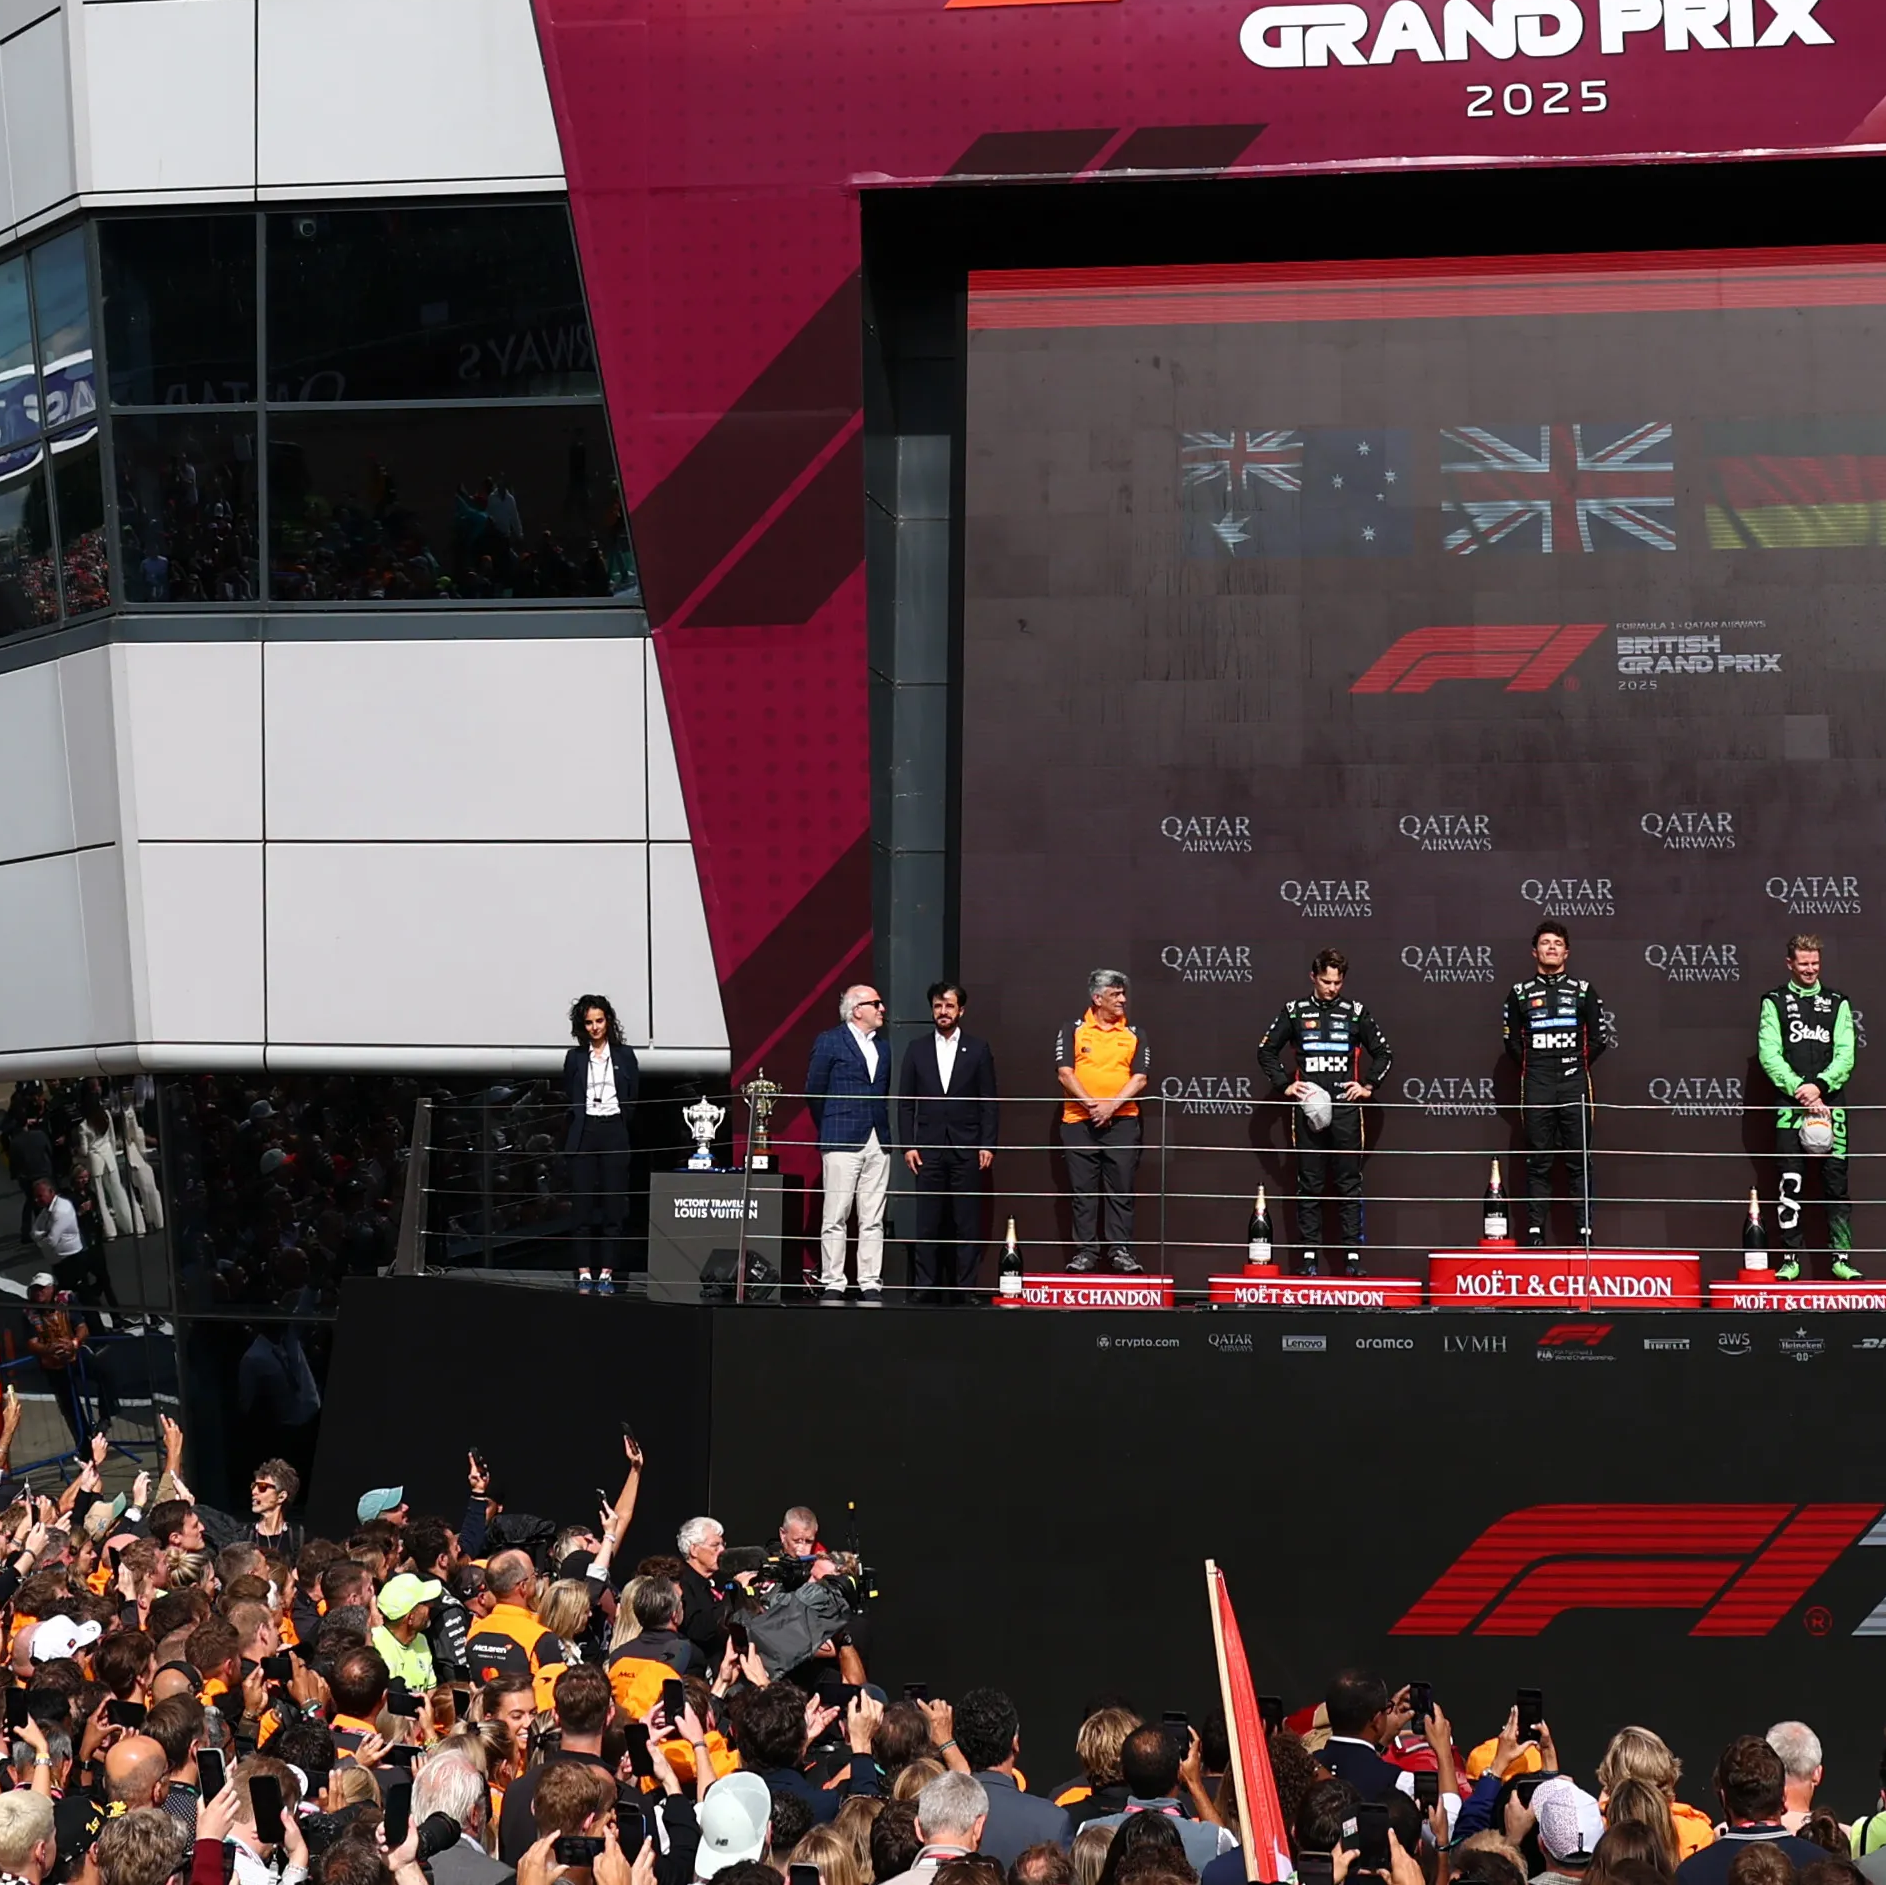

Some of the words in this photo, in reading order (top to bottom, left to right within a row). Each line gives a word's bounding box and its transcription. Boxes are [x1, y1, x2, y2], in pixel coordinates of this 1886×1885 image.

[1466, 80, 1609, 119] 2025
[1616, 622, 1666, 631] FORMULA
[1684, 621, 1718, 630] QATAR
[1720, 620, 1767, 629] AIRWAYS
[1617, 635, 1721, 654] BRITISH
[1348, 624, 1608, 693] F1
[1618, 655, 1715, 674] GRAND
[1717, 654, 1783, 673] PRIX
[1618, 680, 1658, 691] 2025
[1161, 816, 1251, 840] QATAR
[1399, 814, 1490, 839] QATAR
[1640, 812, 1734, 837] QATAR
[1182, 839, 1252, 853] AIRWAYS
[1421, 837, 1492, 852] AIRWAYS
[1663, 835, 1736, 850] AIRWAYS
[1280, 880, 1371, 905] QATAR
[1520, 878, 1614, 903] QATAR
[1765, 876, 1860, 901] QATAR
[1301, 904, 1373, 918] AIRWAYS
[1543, 901, 1615, 917] AIRWAYS
[1788, 899, 1862, 915] AIRWAYS
[1161, 945, 1252, 970] QATAR
[1401, 945, 1494, 970] QATAR
[1644, 943, 1739, 968] QATAR
[1182, 969, 1253, 983] AIRWAYS
[1423, 968, 1495, 983] AIRWAYS
[1668, 967, 1741, 982] AIRWAYS
[1789, 1020, 1831, 1044] Stake
[1161, 1076, 1252, 1101] QATAR
[1403, 1078, 1495, 1103] QATAR
[1649, 1077, 1743, 1103] QATAR
[1182, 1100, 1254, 1115] AIRWAYS
[1425, 1101, 1497, 1117] AIRWAYS
[1672, 1101, 1745, 1117] AIRWAYS
[1831, 1108, 1848, 1161] NICO
[674, 1198, 710, 1207] VICTORY
[675, 1207, 707, 1218] LOUIS
[1455, 1269, 1523, 1296] MOËT
[1527, 1274, 1545, 1297] &
[1549, 1275, 1672, 1298] CHANDON
[1021, 1285, 1062, 1304] MOËT
[1063, 1289, 1076, 1305] &
[1077, 1288, 1161, 1306] CHANDON
[1234, 1285, 1281, 1304] MOËT
[1282, 1290, 1296, 1305] &
[1297, 1289, 1384, 1306] CHANDON
[1733, 1291, 1782, 1309] MOËT
[1784, 1294, 1798, 1310] &
[1799, 1294, 1886, 1310] CHANDON
[1115, 1336, 1179, 1350] crypto.com
[1208, 1333, 1253, 1346] QATAR
[1285, 1337, 1324, 1349] Lenovo
[1355, 1337, 1414, 1350] aramco
[1443, 1335, 1508, 1353] LVMH
[1644, 1339, 1690, 1350] PIRELLI
[1718, 1332, 1751, 1346] aws
[1781, 1340, 1823, 1350] Heineken
[1219, 1344, 1253, 1352] AIRWAYS
[1387, 1502, 1885, 1637] F1
[472, 1644, 507, 1655] McLaren
